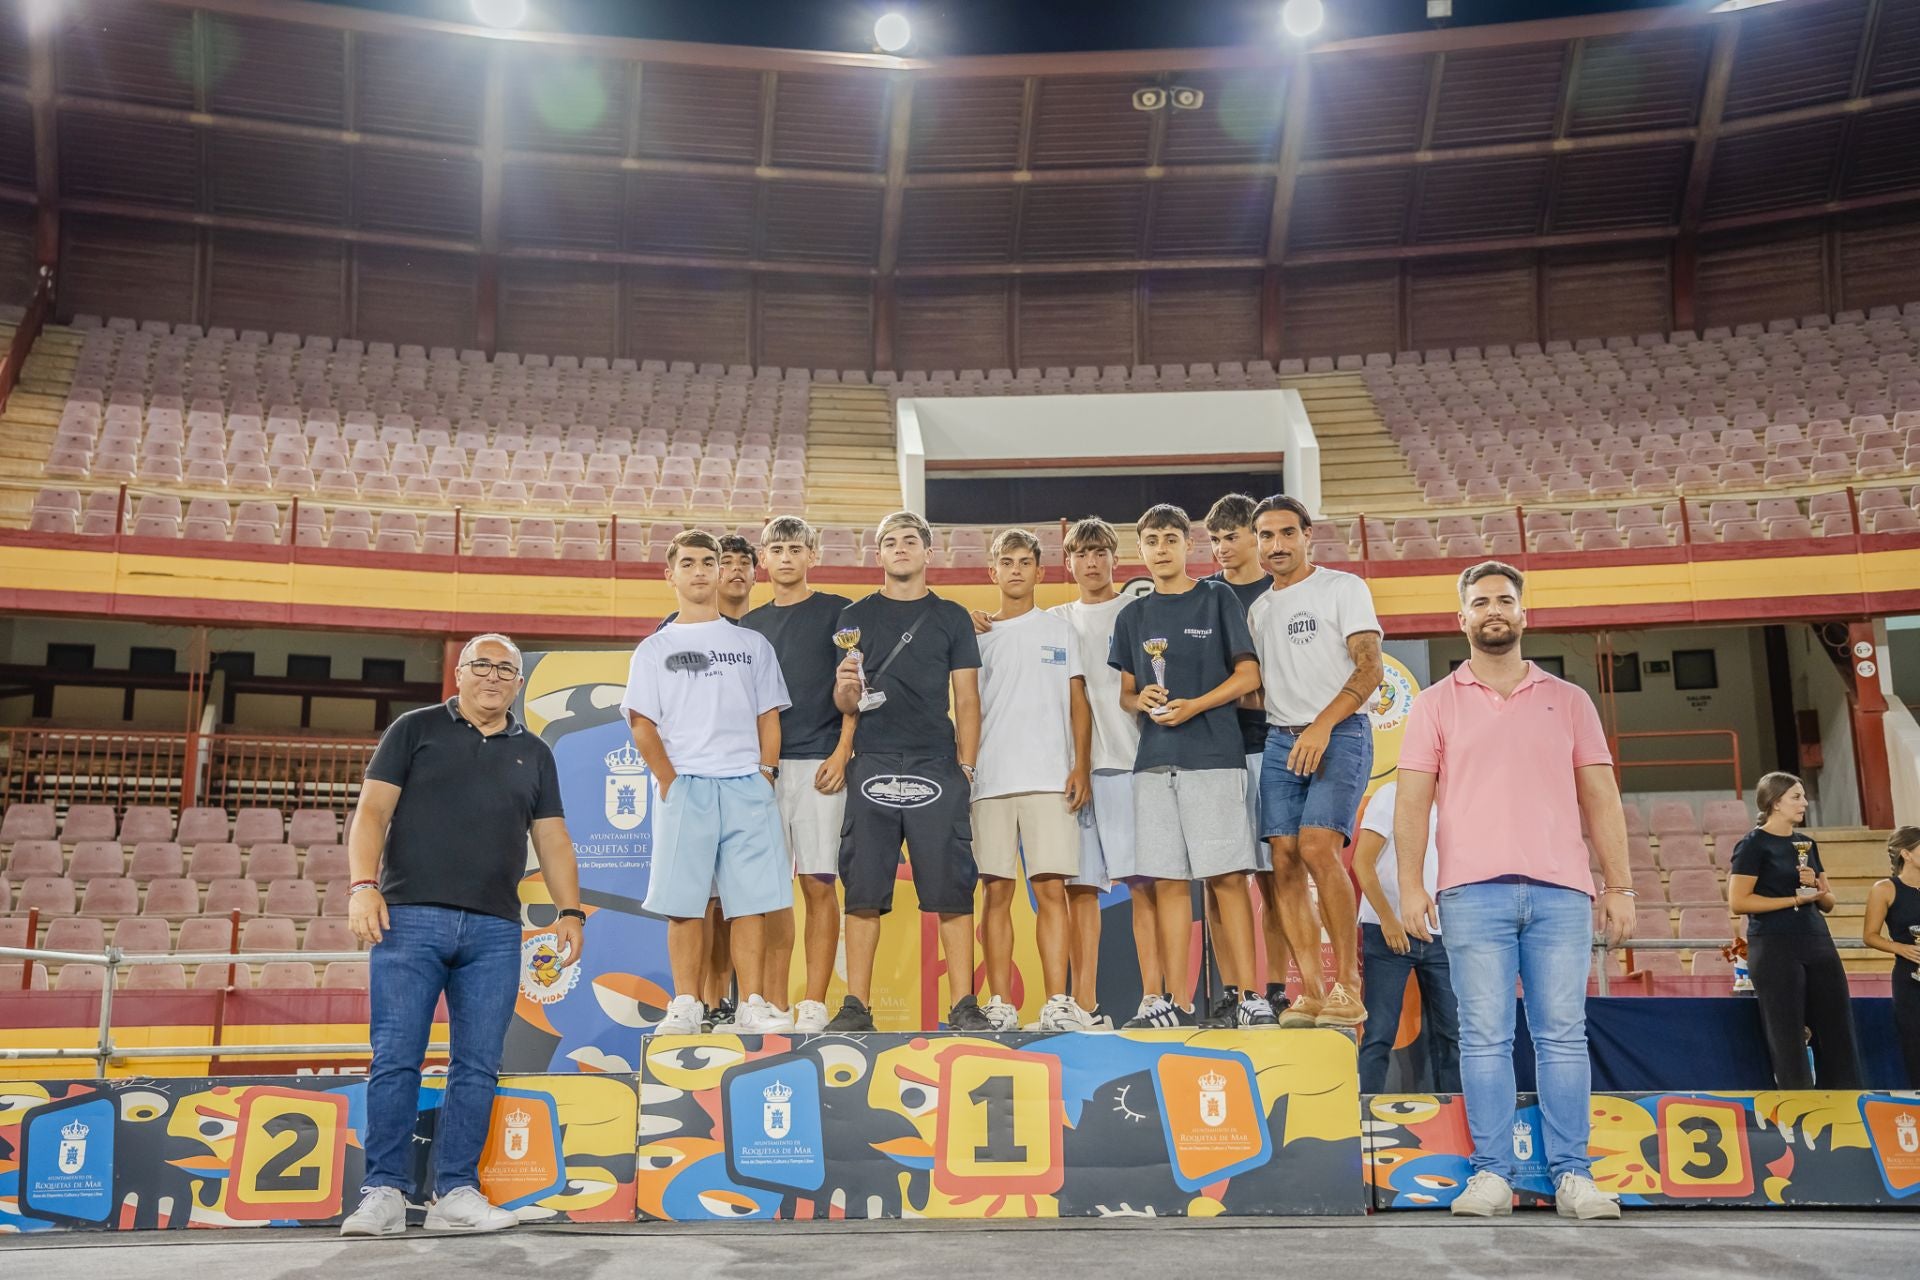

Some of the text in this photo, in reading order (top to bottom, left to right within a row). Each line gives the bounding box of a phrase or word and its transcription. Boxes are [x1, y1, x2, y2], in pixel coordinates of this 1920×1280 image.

[1288, 619, 1316, 636] 90210
[1856, 646, 1862, 654] 6
[708, 650, 752, 666] Angels
[1402, 695, 1412, 714] MAR
[1378, 720, 1399, 731] VIDA
[572, 842, 648, 856] ROQUETAS DE
[590, 861, 617, 869] Deportes,
[524, 934, 558, 950] ROQUET
[527, 991, 563, 1003] LA VIDA
[968, 1076, 1027, 1162] 1
[1180, 1134, 1217, 1143] ROQUETAS
[255, 1112, 320, 1191] 2
[742, 1147, 780, 1155] ROQUETAS
[1678, 1116, 1728, 1179] 3
